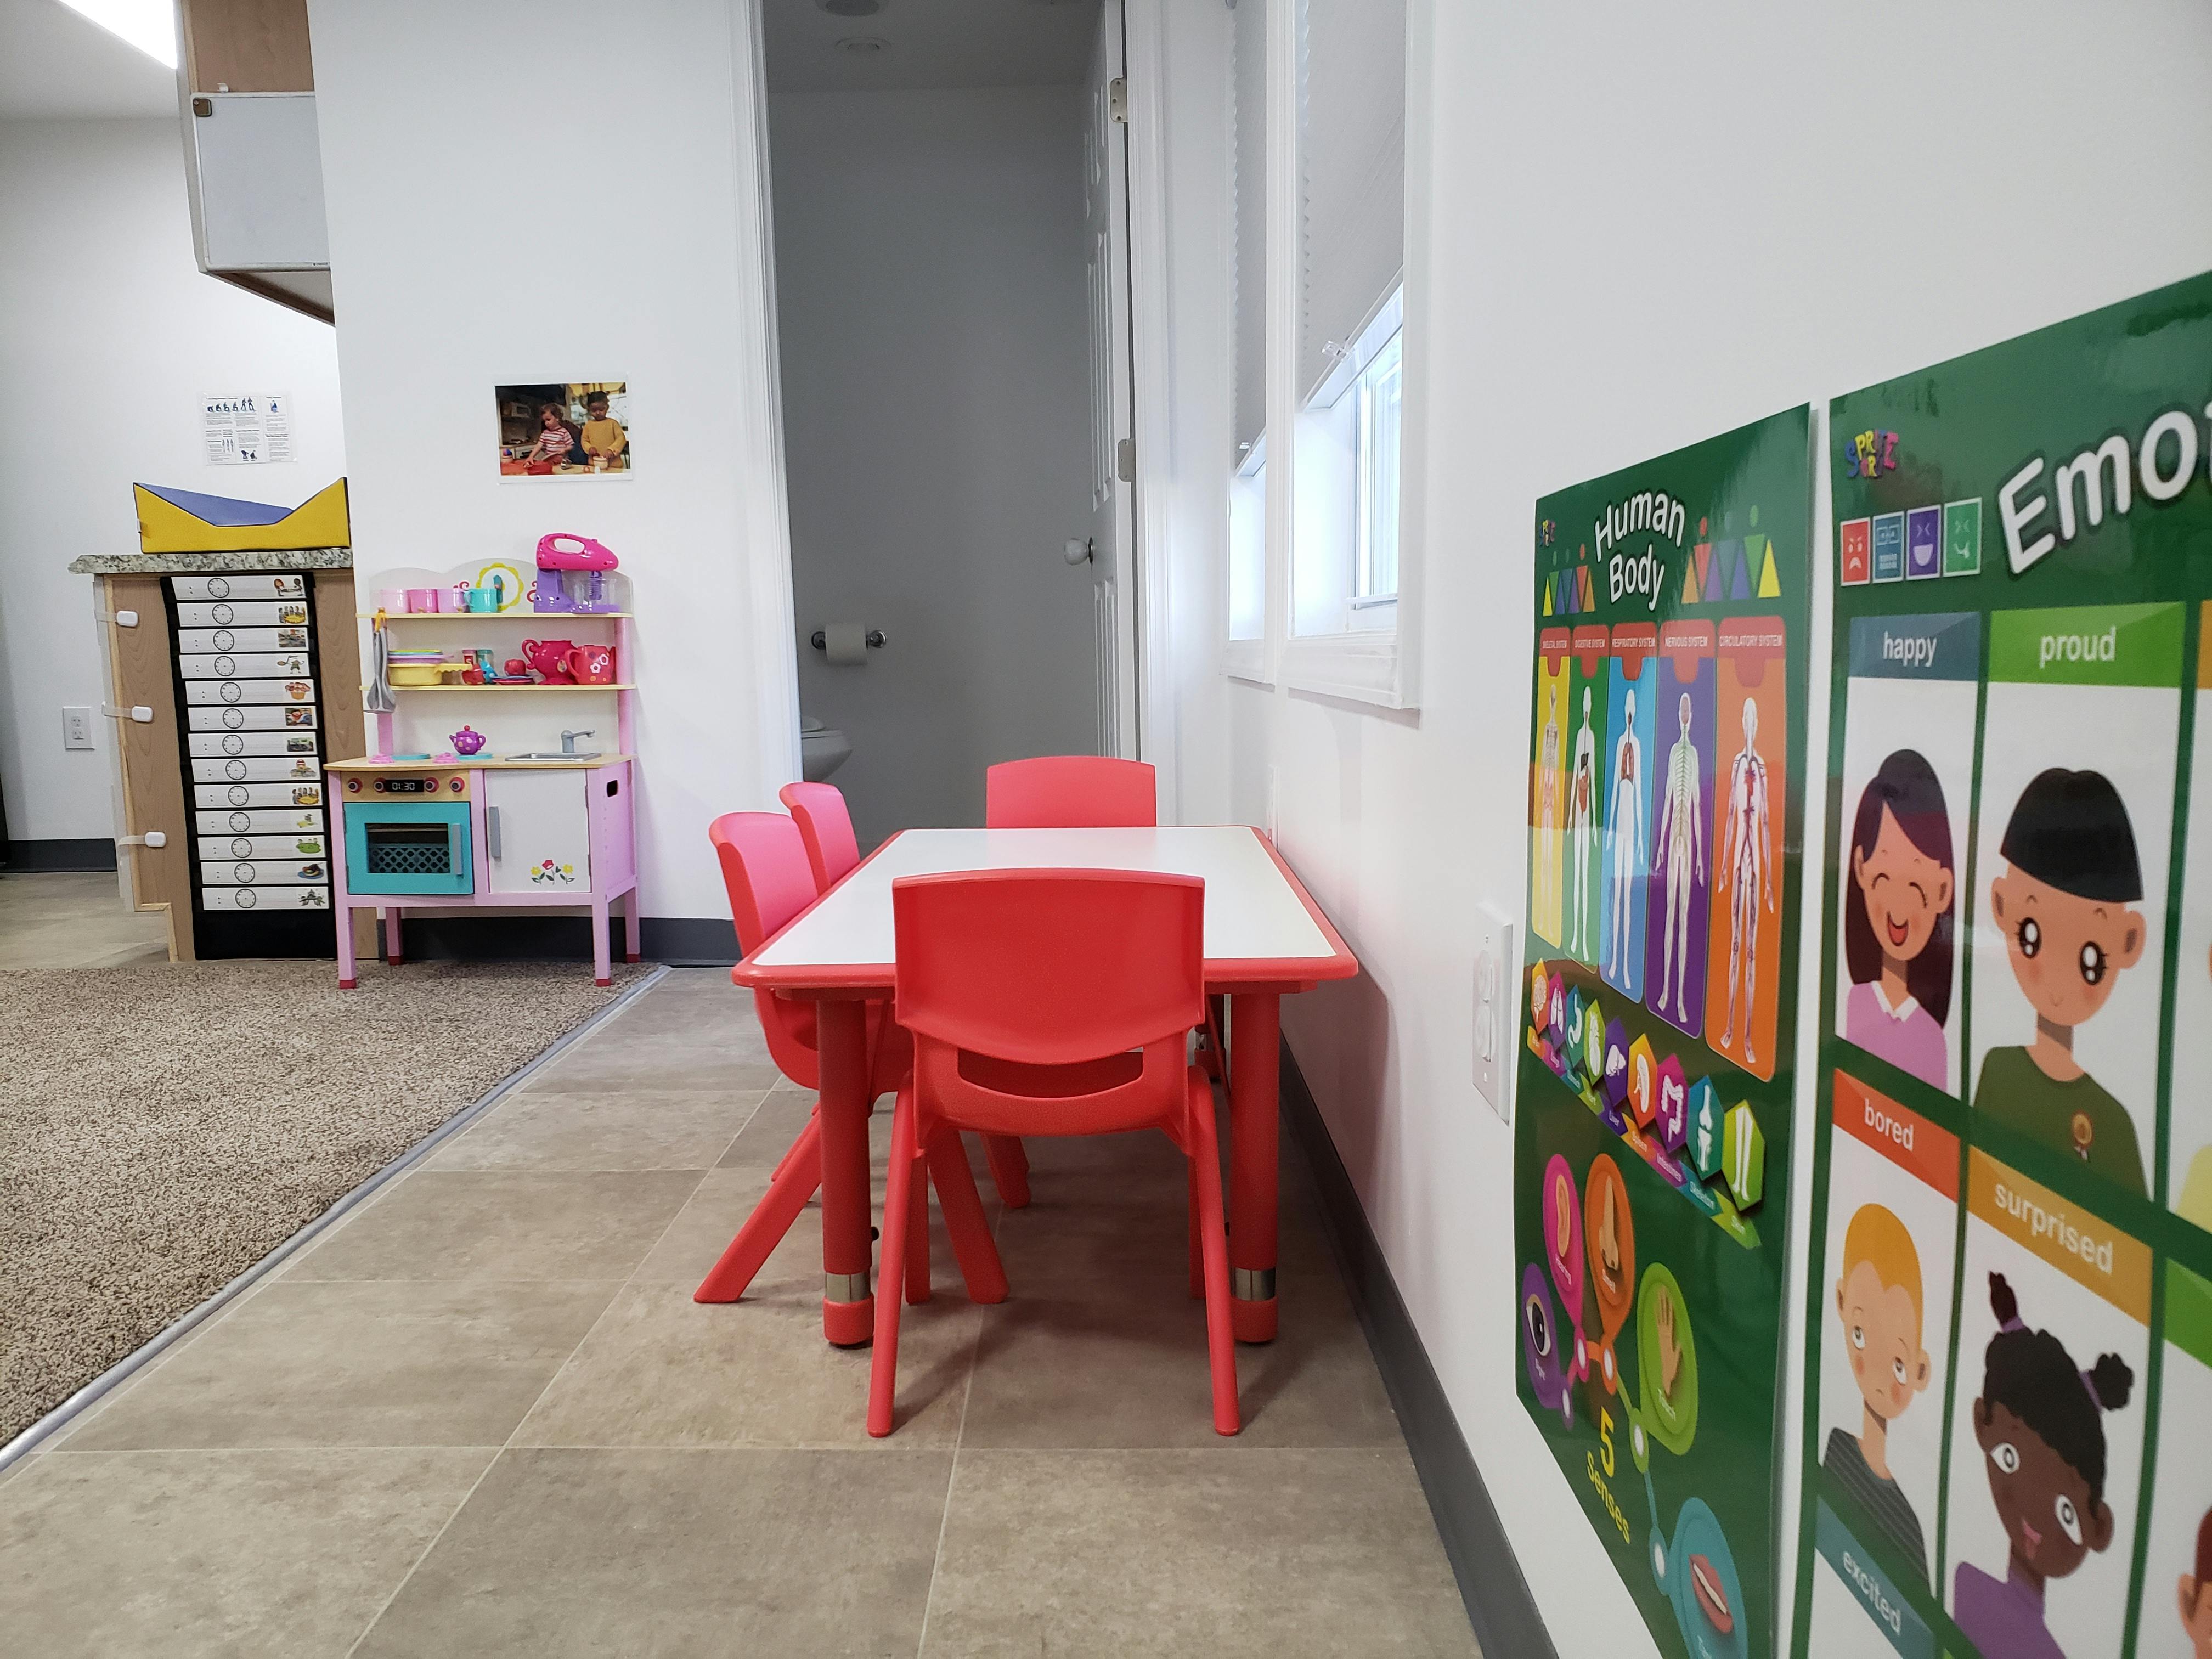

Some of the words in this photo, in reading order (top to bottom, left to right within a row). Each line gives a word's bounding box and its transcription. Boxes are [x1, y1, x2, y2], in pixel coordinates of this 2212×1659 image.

[1595, 492, 1685, 562] Human
[1610, 544, 1664, 611] Body
[1638, 637, 1655, 647] SYSTEM
[1688, 636, 1707, 647] SYSTEM
[1758, 634, 1782, 646] SYSTEM
[1883, 631, 1937, 667] happy
[2039, 626, 2116, 669] proud
[1865, 1098, 1914, 1152] bored
[1995, 1183, 2113, 1274] surprised
[1600, 1406, 1615, 1479] 5
[1587, 1450, 1630, 1545] Senses
[1843, 1551, 1901, 1635] excited
